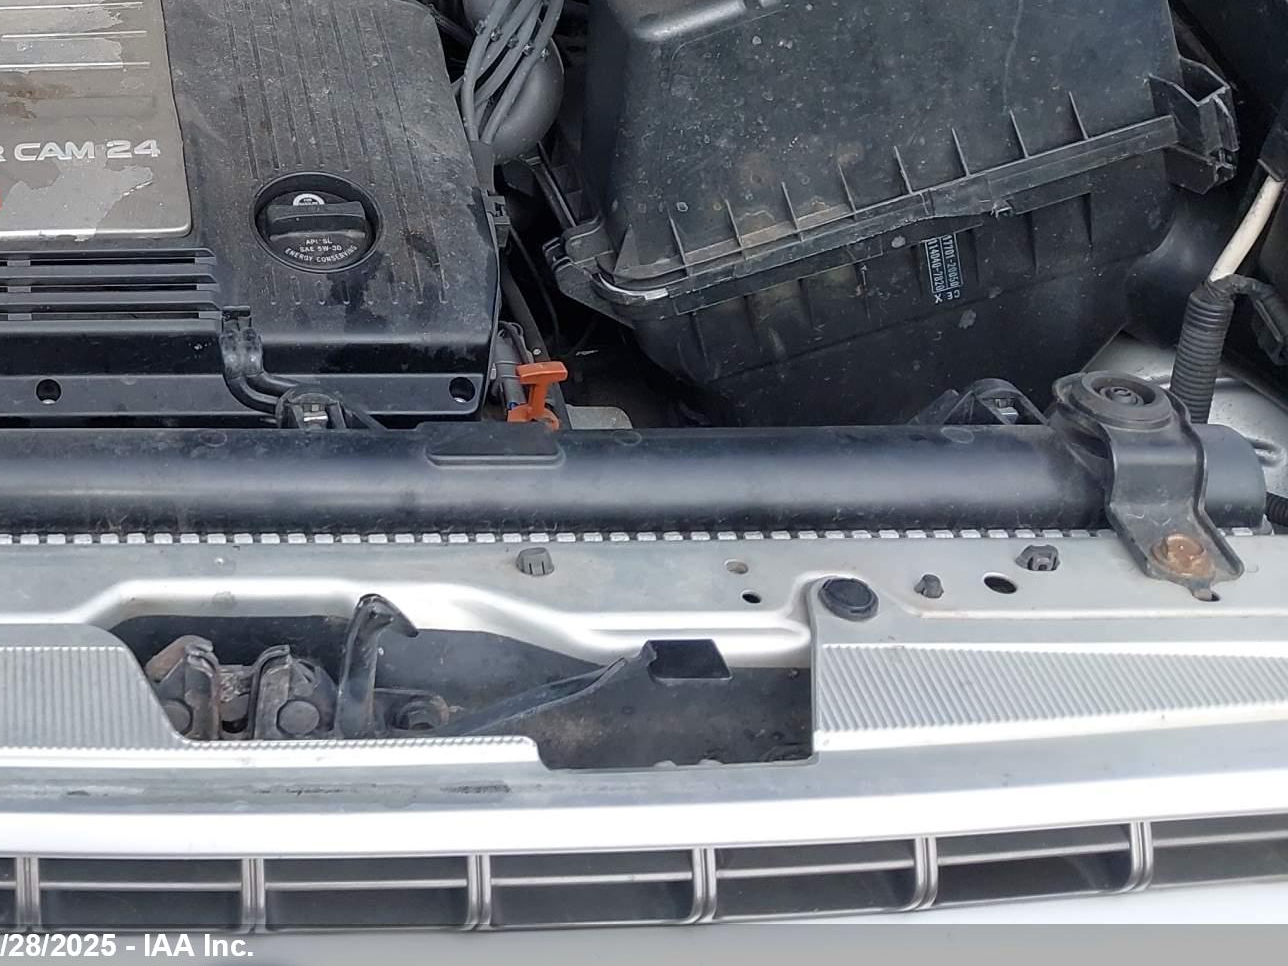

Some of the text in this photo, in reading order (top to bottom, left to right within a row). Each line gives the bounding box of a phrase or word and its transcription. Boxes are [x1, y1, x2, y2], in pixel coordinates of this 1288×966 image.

[14, 141, 96, 161] CAM
[107, 139, 161, 159] 24
[285, 245, 358, 263] ENERGY CONSERVING
[300, 245, 314, 253] SAE
